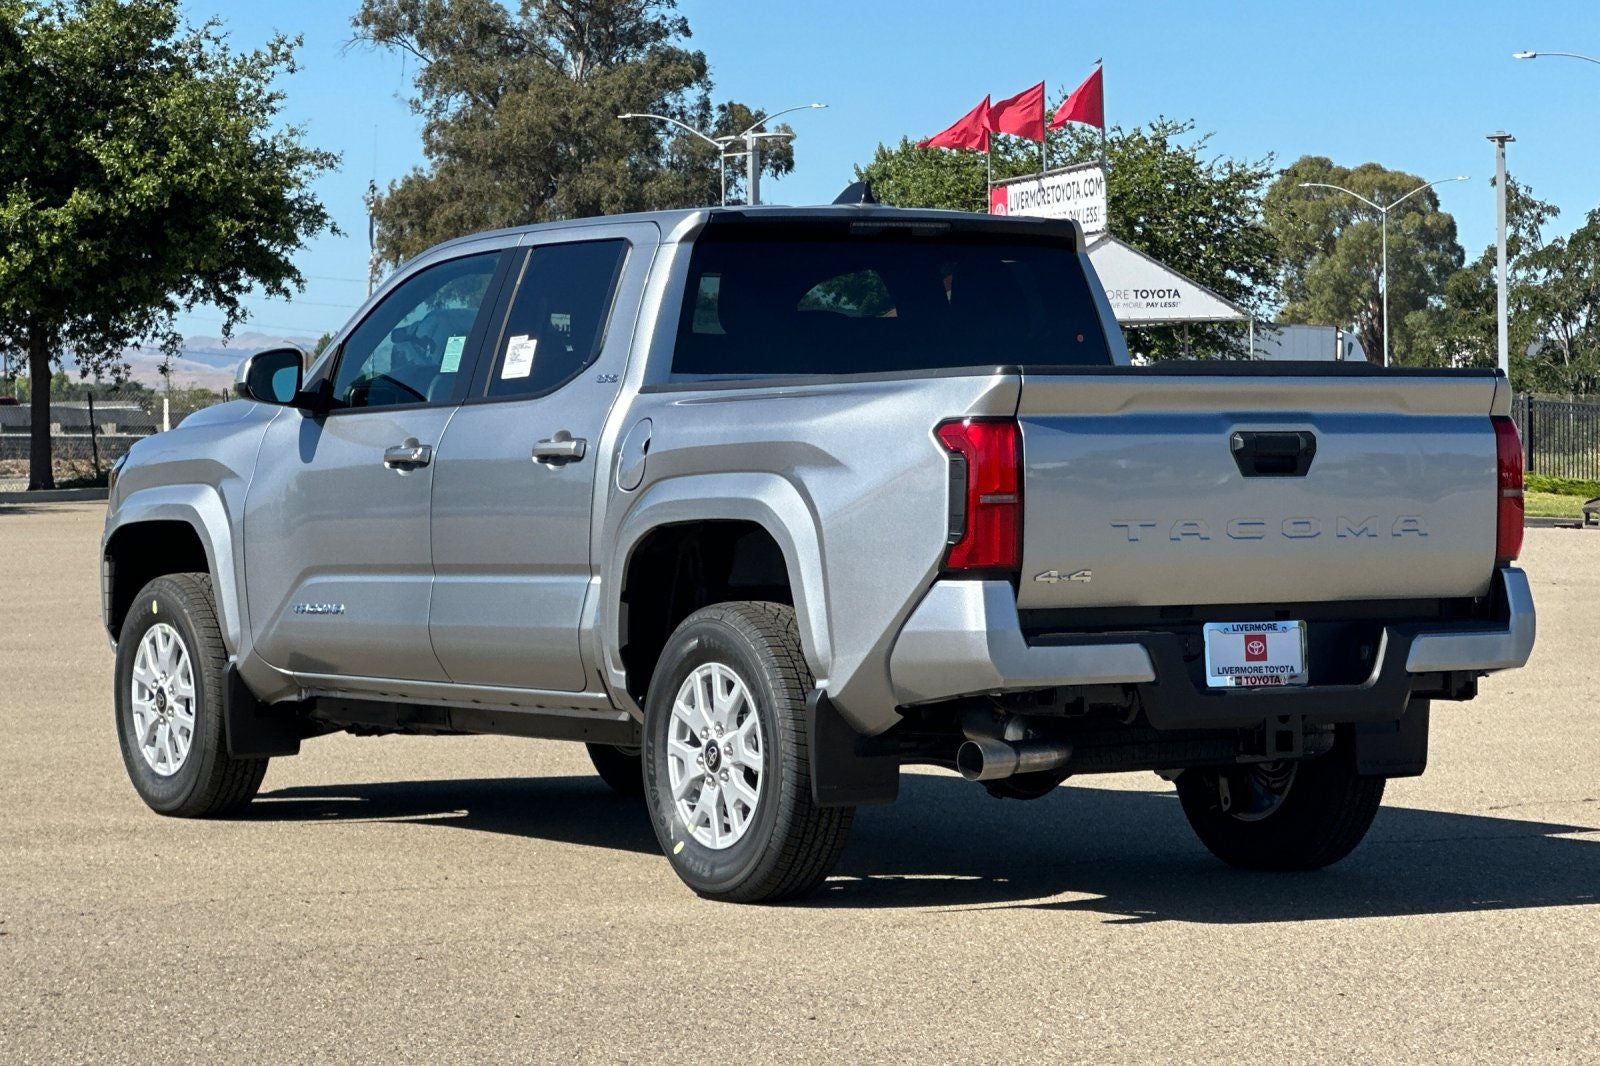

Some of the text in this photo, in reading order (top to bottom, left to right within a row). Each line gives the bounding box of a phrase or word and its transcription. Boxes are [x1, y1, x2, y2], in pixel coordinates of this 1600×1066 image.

[1009, 176, 1103, 212] LIVERMORETOYOTA.COM
[1105, 288, 1182, 300] ORE TOYOTA
[1109, 514, 1429, 542] TACOMA
[1231, 622, 1279, 633] LIVERMORE
[1217, 665, 1295, 675] LIVERMORE TOYOTA
[1244, 675, 1282, 686] TOYOTA
